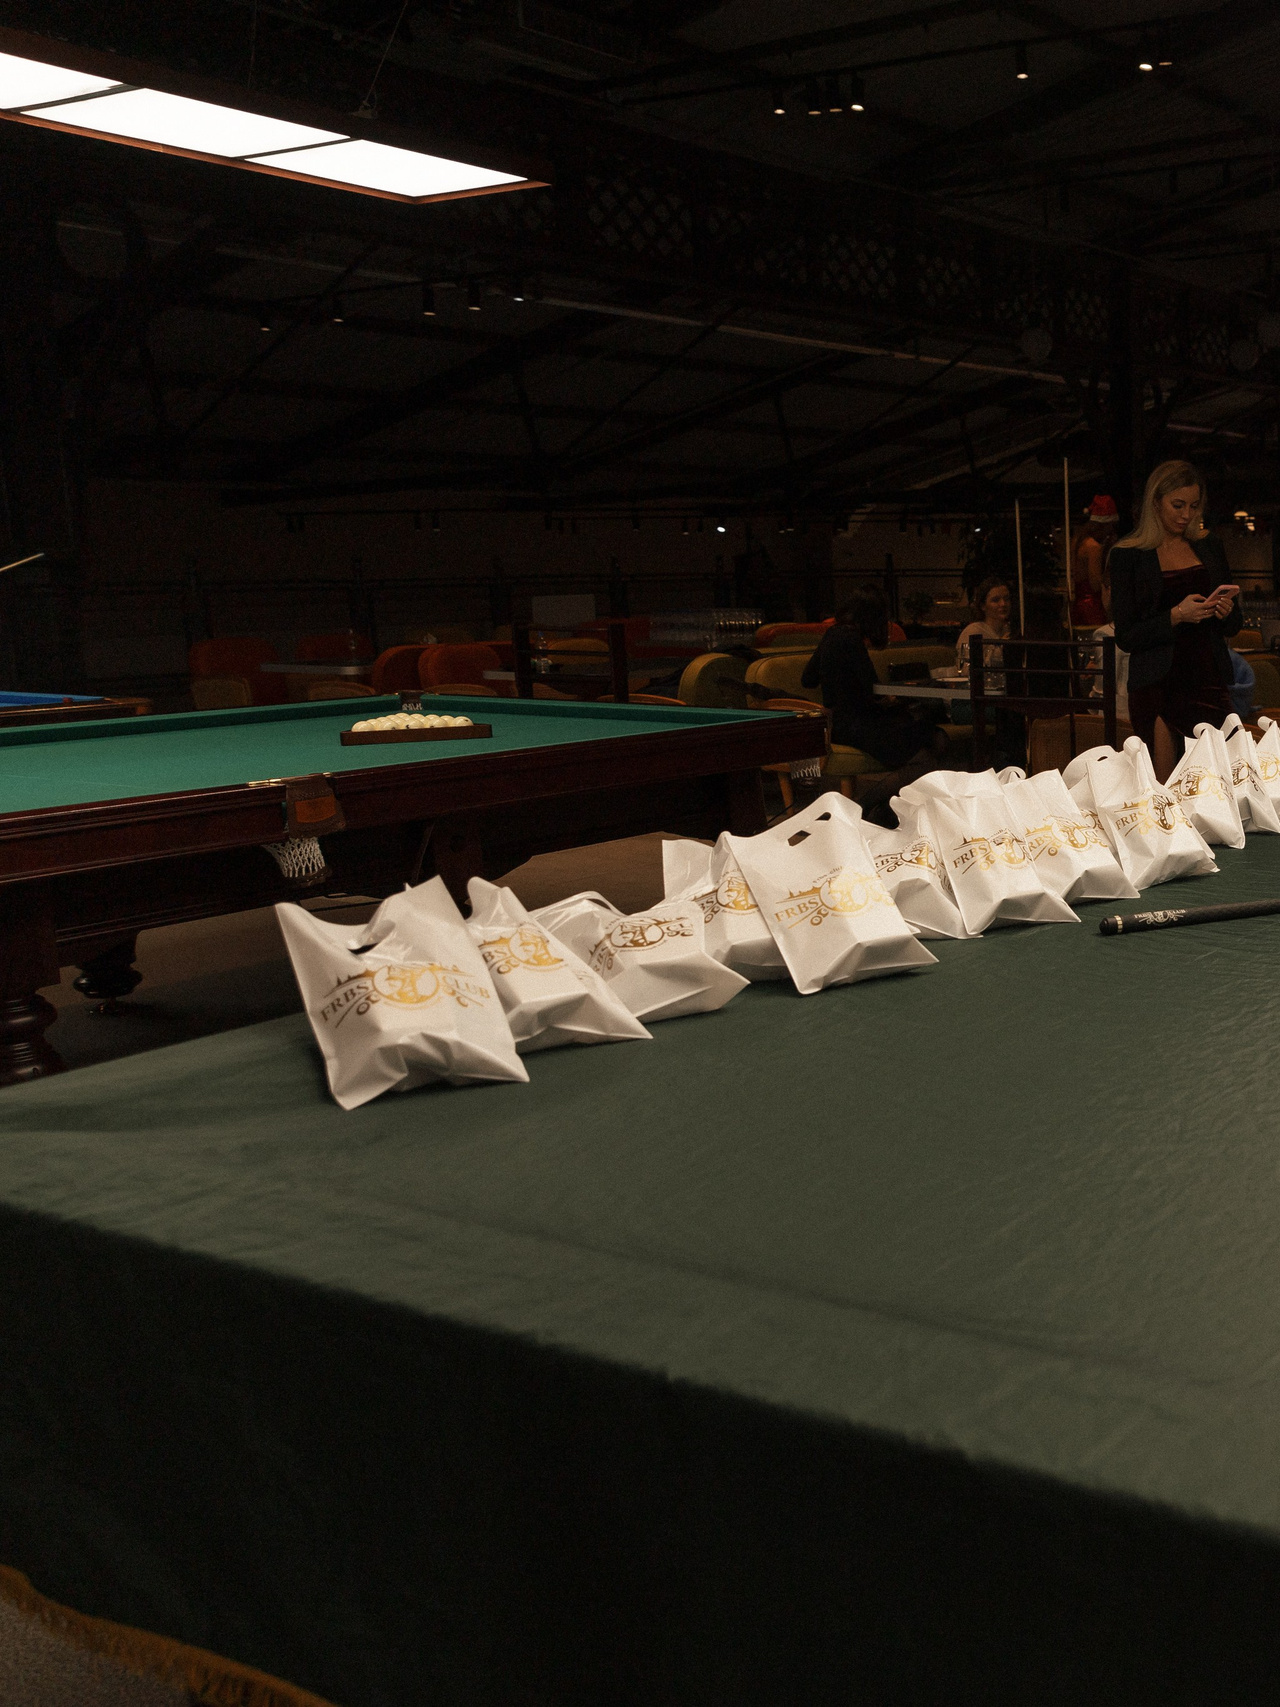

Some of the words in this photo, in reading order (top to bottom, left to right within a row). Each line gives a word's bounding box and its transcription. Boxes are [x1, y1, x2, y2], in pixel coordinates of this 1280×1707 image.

[953, 844, 988, 868] FRBS
[774, 897, 819, 922] FRBS
[320, 981, 370, 1022] FRBS
[442, 974, 491, 1000] CLUB
